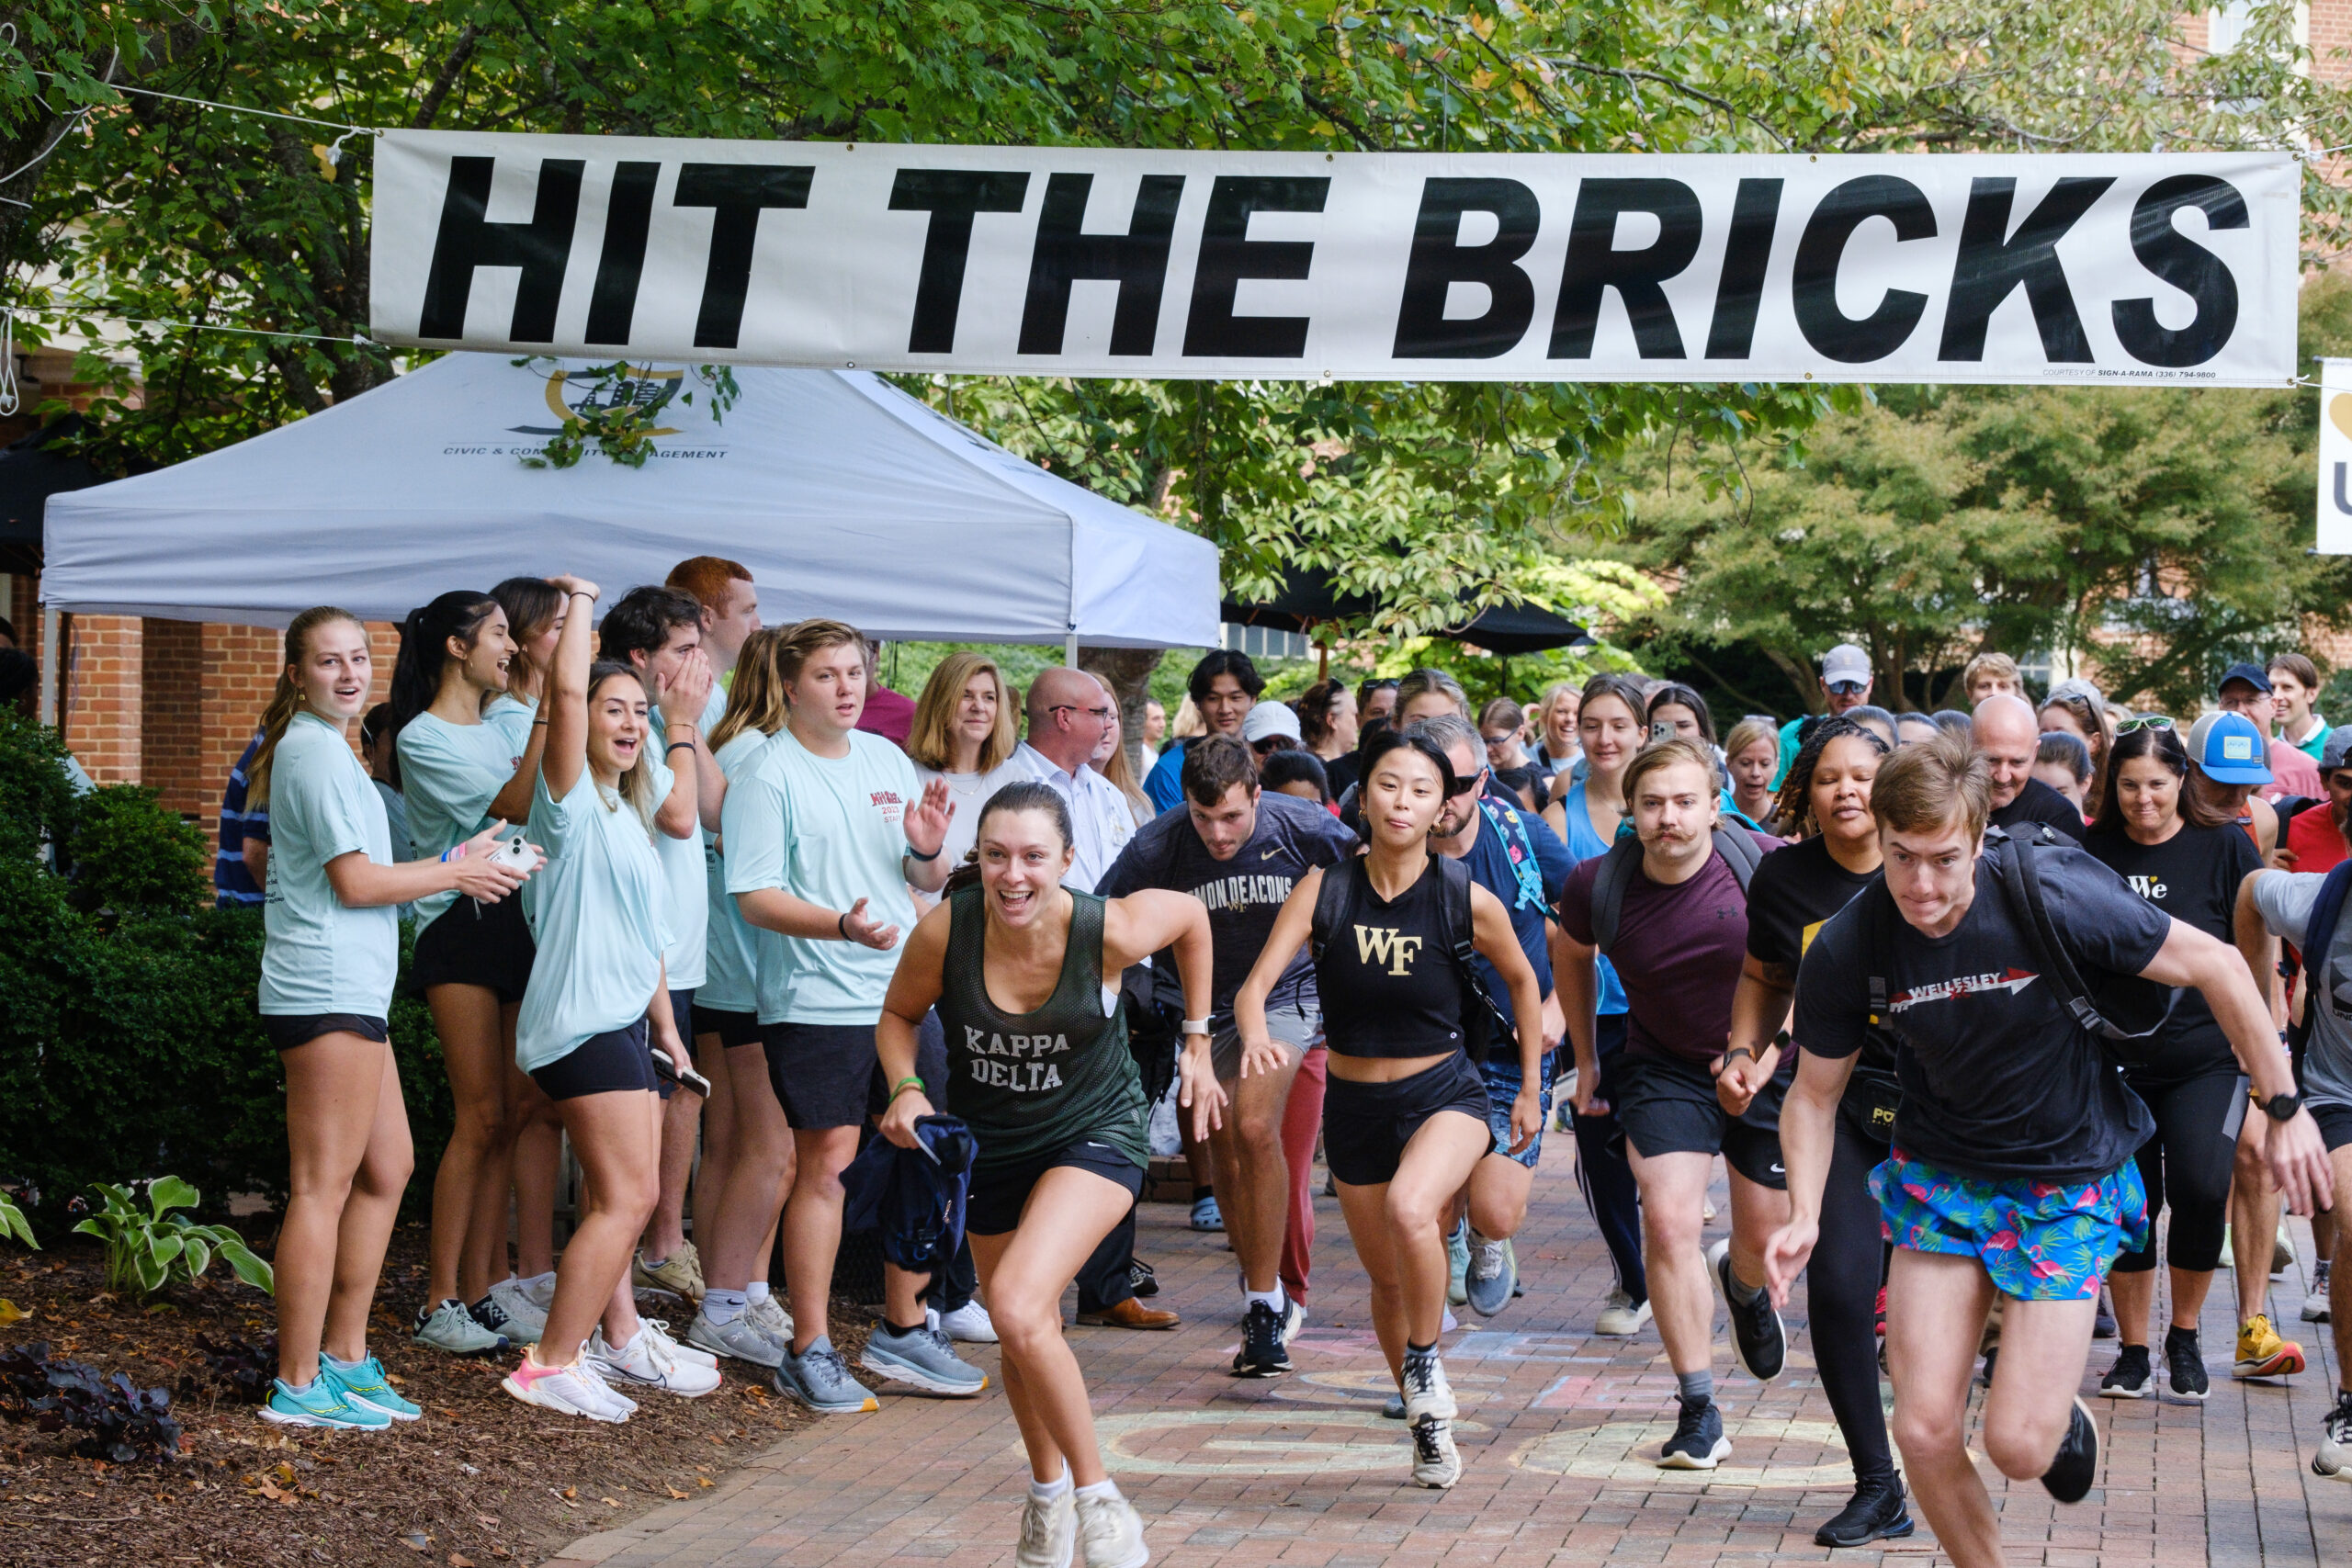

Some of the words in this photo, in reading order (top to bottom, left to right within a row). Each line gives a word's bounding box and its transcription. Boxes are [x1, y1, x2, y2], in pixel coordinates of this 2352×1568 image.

[418, 155, 816, 349] HIT
[888, 168, 1332, 358] THE
[1392, 174, 2251, 369] BRICKS
[2042, 368, 2085, 377] COURTESY
[2086, 368, 2097, 377] OF
[2098, 369, 2154, 378] SIGN-A-RAMA
[2155, 370, 2177, 378] (336)
[444, 446, 488, 456] CIVIC
[492, 446, 503, 456] &
[510, 447, 608, 457] COMITY
[1186, 879, 1228, 910] MON
[1228, 874, 1292, 905] DEACONS
[1353, 924, 1422, 976] WF
[1908, 972, 2001, 1002] WELLESLEY
[964, 1024, 1070, 1058] KAPPA
[970, 1058, 1063, 1092] DELTA
